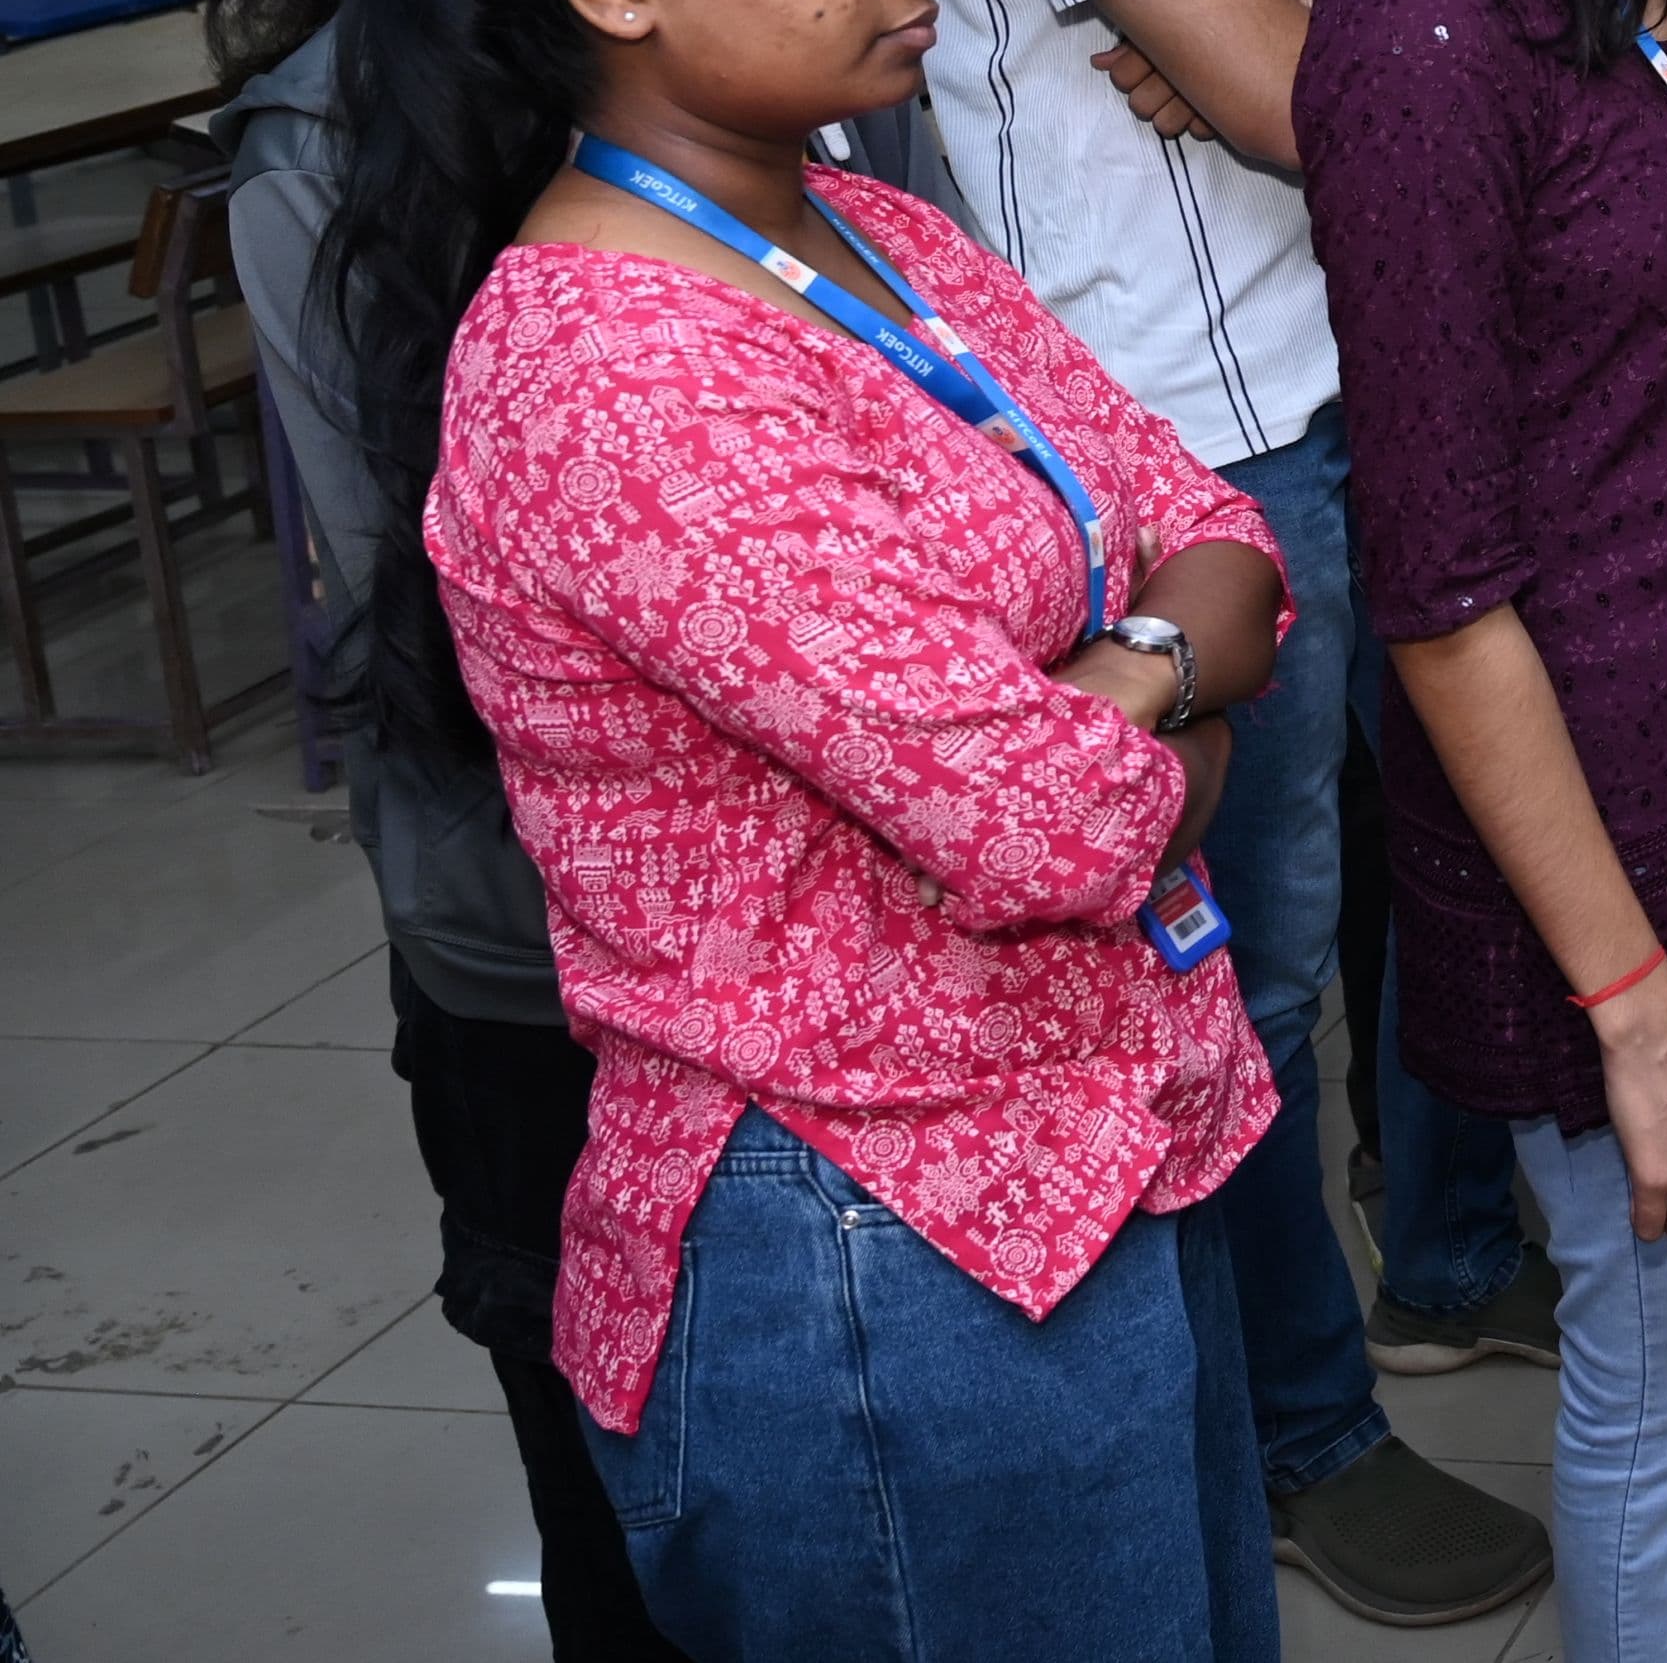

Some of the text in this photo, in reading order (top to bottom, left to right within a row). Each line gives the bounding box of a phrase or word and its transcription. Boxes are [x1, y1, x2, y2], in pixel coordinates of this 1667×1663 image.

[629, 170, 698, 213] KITCoEK
[876, 327, 934, 377] KITCoEK
[1006, 409, 1052, 460] KITCoEK
